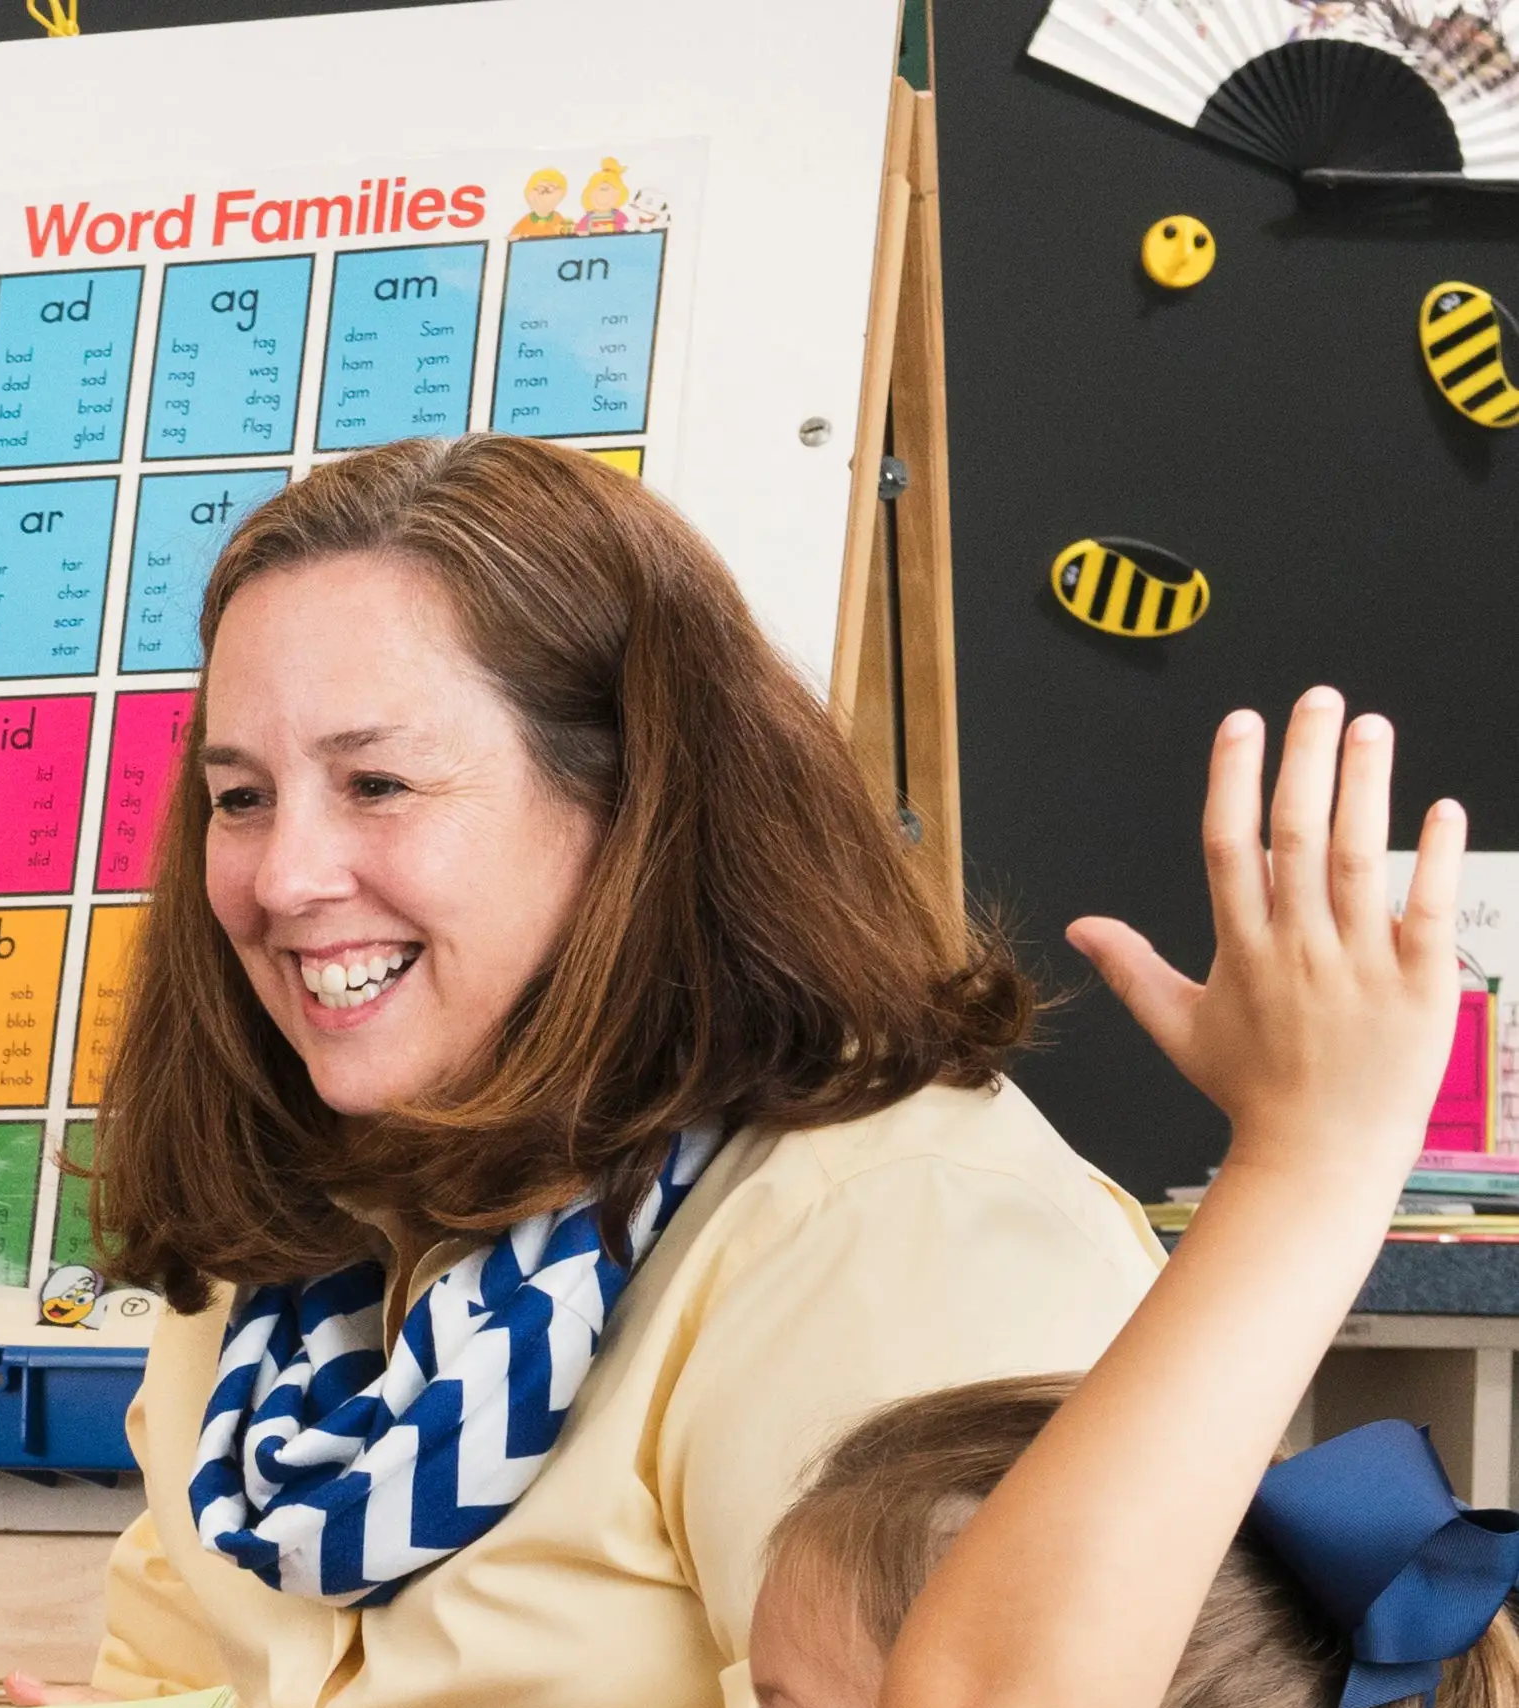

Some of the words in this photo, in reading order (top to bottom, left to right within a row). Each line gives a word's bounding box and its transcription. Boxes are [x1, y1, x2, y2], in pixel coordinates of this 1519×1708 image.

[25, 193, 196, 258] Word
[211, 176, 486, 247] Families
[558, 258, 609, 282] an
[374, 276, 437, 301] am
[40, 280, 93, 323] ad
[211, 290, 259, 332] ag
[420, 320, 454, 337] Sam
[6, 347, 33, 363] bad
[84, 343, 112, 365] pad
[172, 339, 199, 359] bag
[253, 338, 276, 355] tag
[518, 342, 543, 358] fan
[417, 355, 449, 372] yam
[2, 376, 30, 391] dad
[81, 371, 107, 386] sad
[249, 367, 279, 383] wag
[78, 398, 113, 414] brad
[245, 390, 280, 411] drag
[592, 395, 627, 411] Stan
[0, 404, 21, 419] lad
[412, 408, 446, 423] slam
[511, 406, 540, 423] pan
[243, 417, 272, 439] flag
[74, 426, 105, 449] glad
[190, 491, 234, 526] at
[20, 511, 63, 534] ar
[52, 644, 79, 656] star
[1, 707, 36, 750] id
[124, 766, 144, 786] big
[3, 1042, 32, 1064] glob
[0, 1070, 33, 1085] knob
